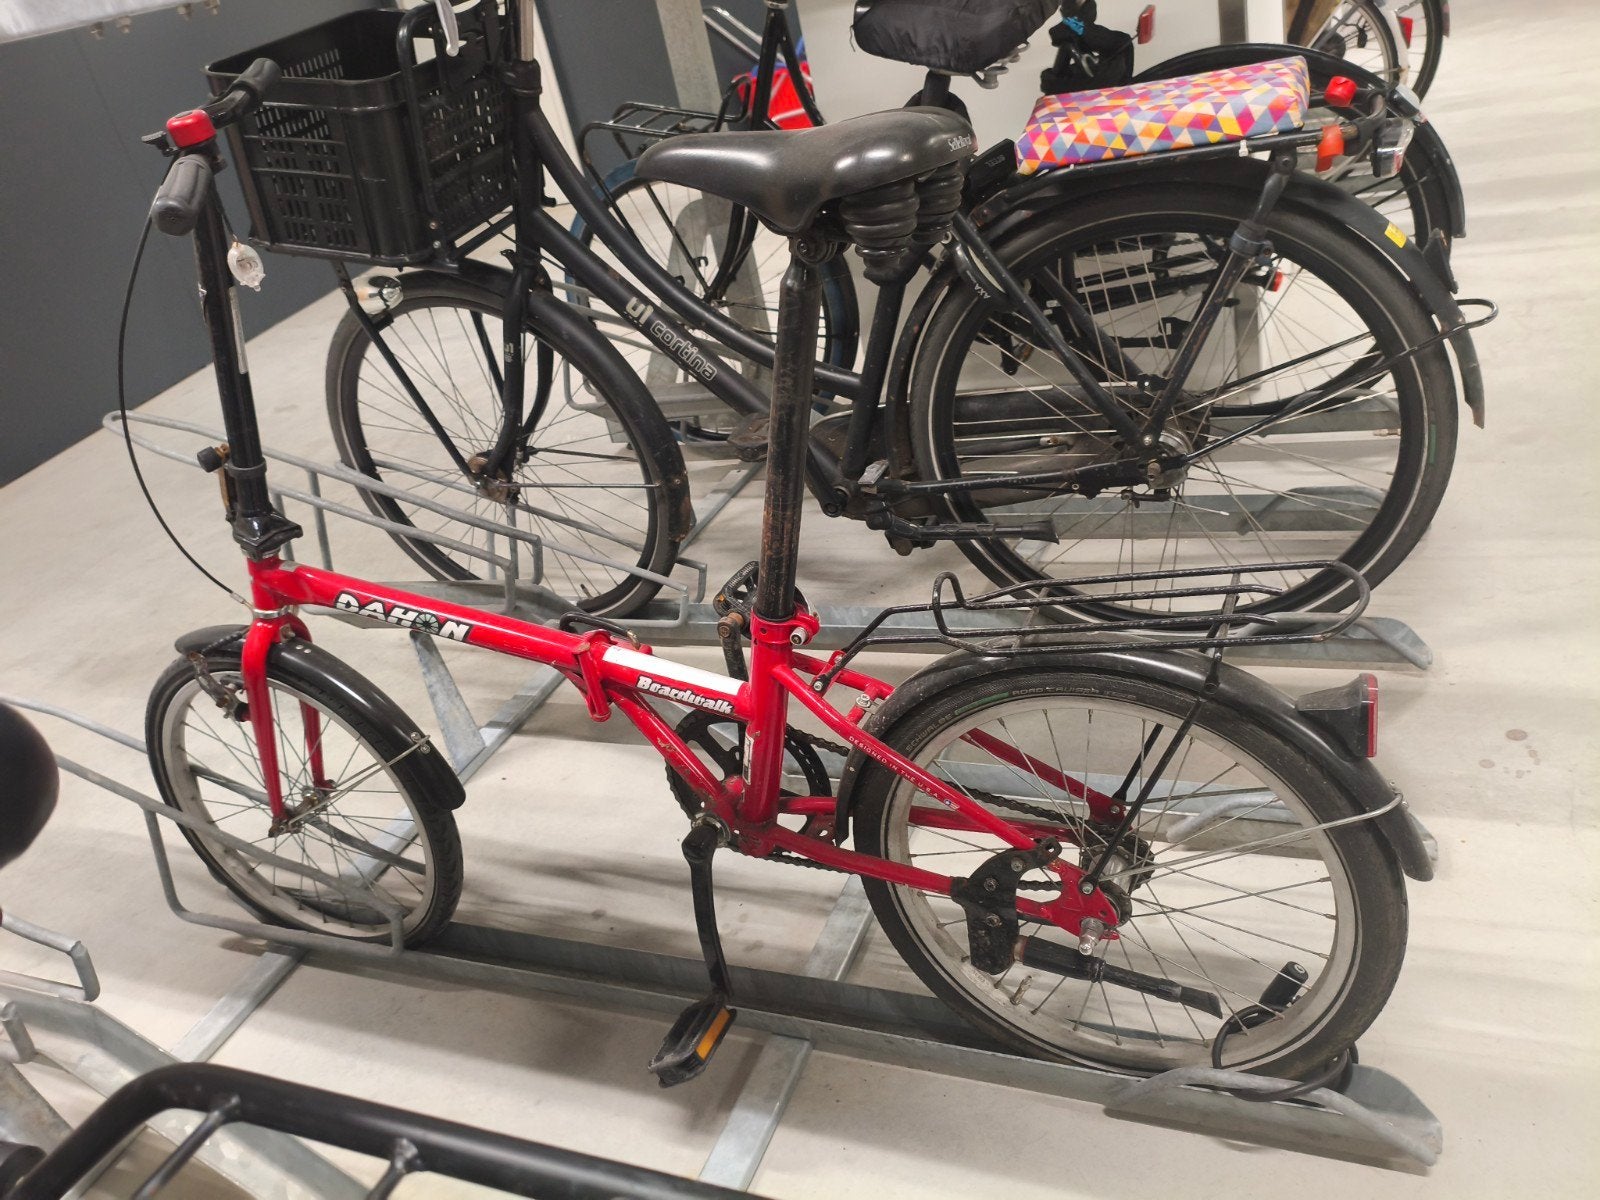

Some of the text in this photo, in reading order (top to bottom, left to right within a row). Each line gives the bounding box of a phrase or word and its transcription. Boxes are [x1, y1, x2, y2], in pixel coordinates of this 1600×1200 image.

[974, 283, 991, 299] AXA
[649, 320, 718, 381] cortina
[334, 592, 471, 642] DAHON
[636, 675, 735, 714] Boardwalk
[848, 735, 888, 764] DESIGNED
[889, 762, 899, 771] IN
[900, 768, 916, 783] THE
